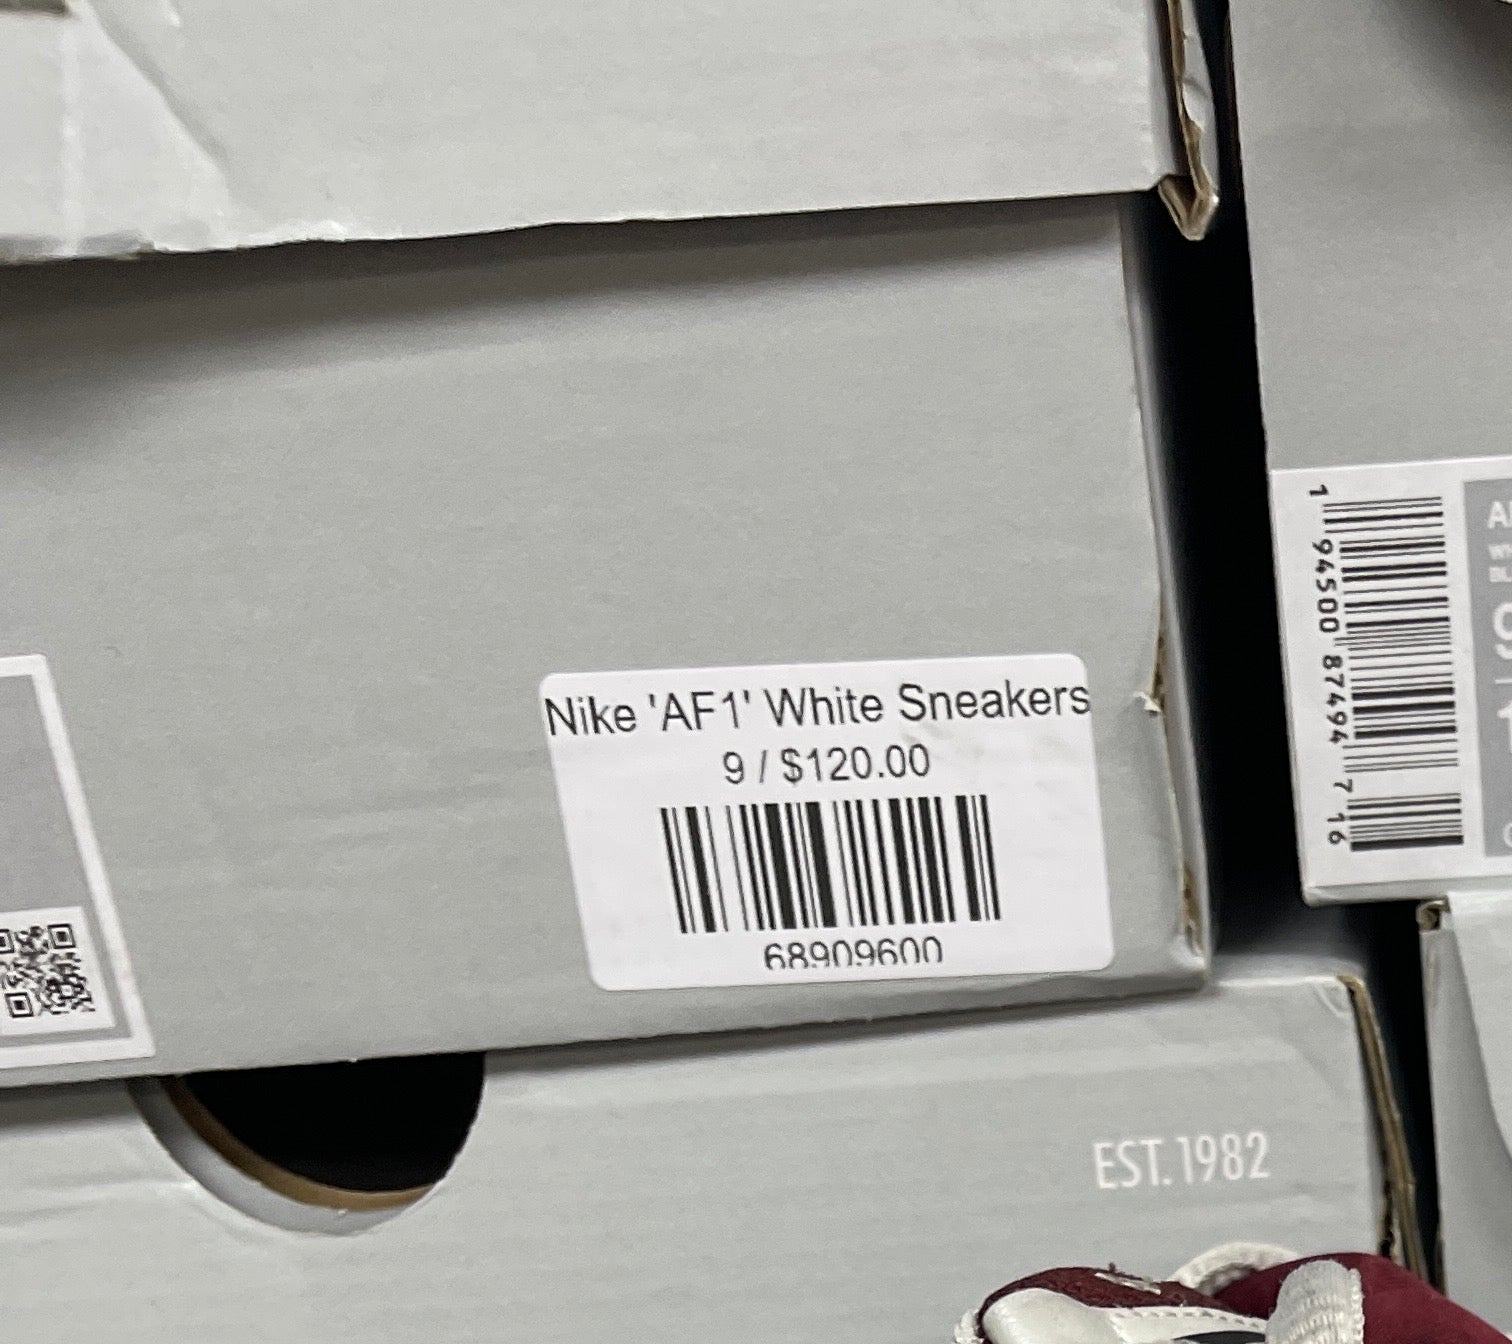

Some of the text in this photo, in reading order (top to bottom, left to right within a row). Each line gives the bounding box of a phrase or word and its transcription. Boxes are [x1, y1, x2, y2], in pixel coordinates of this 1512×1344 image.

[1312, 538, 1340, 633] 94500
[545, 679, 1091, 736] Nike 'AF1' White Sneakers
[1322, 654, 1349, 744] 87494
[722, 750, 745, 785] 9
[780, 743, 930, 788] $120.00
